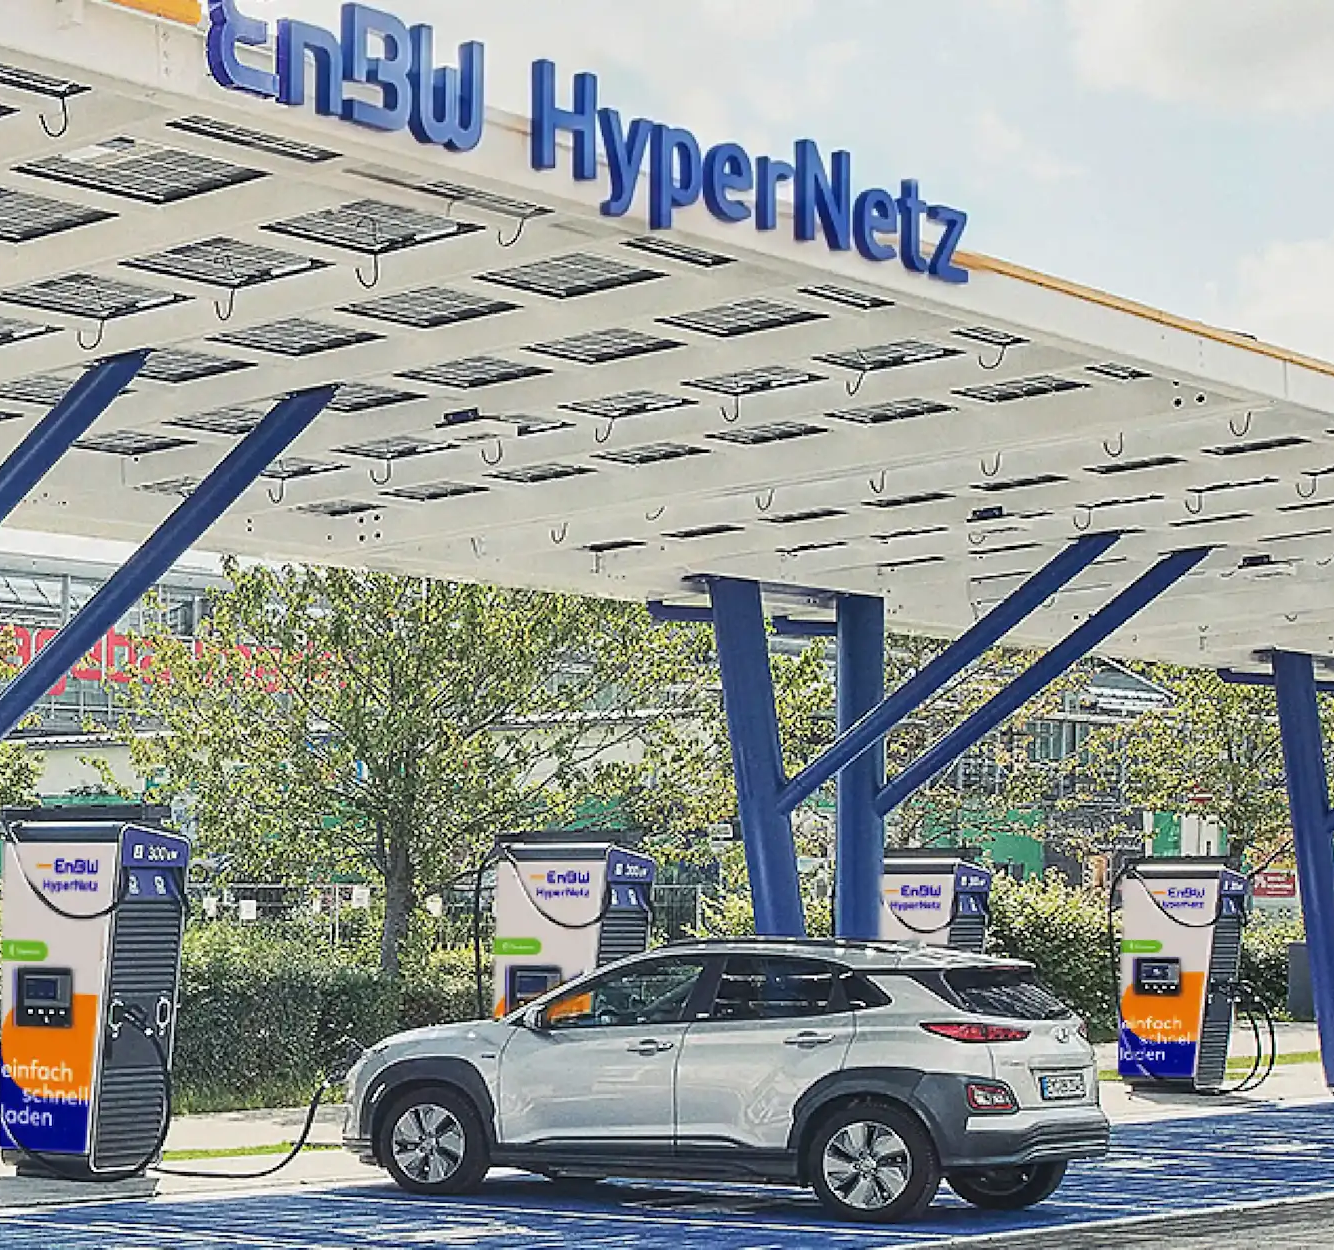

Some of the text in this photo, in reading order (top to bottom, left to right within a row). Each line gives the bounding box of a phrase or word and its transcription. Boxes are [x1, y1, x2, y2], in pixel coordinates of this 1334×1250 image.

[207, 0, 968, 283] EnBW HyperNetz
[53, 858, 99, 874] EnBW
[546, 870, 590, 884] EnBW
[0, 1057, 74, 1083] einfach
[21, 1083, 89, 1108] schnell
[0, 1103, 53, 1127] laden
